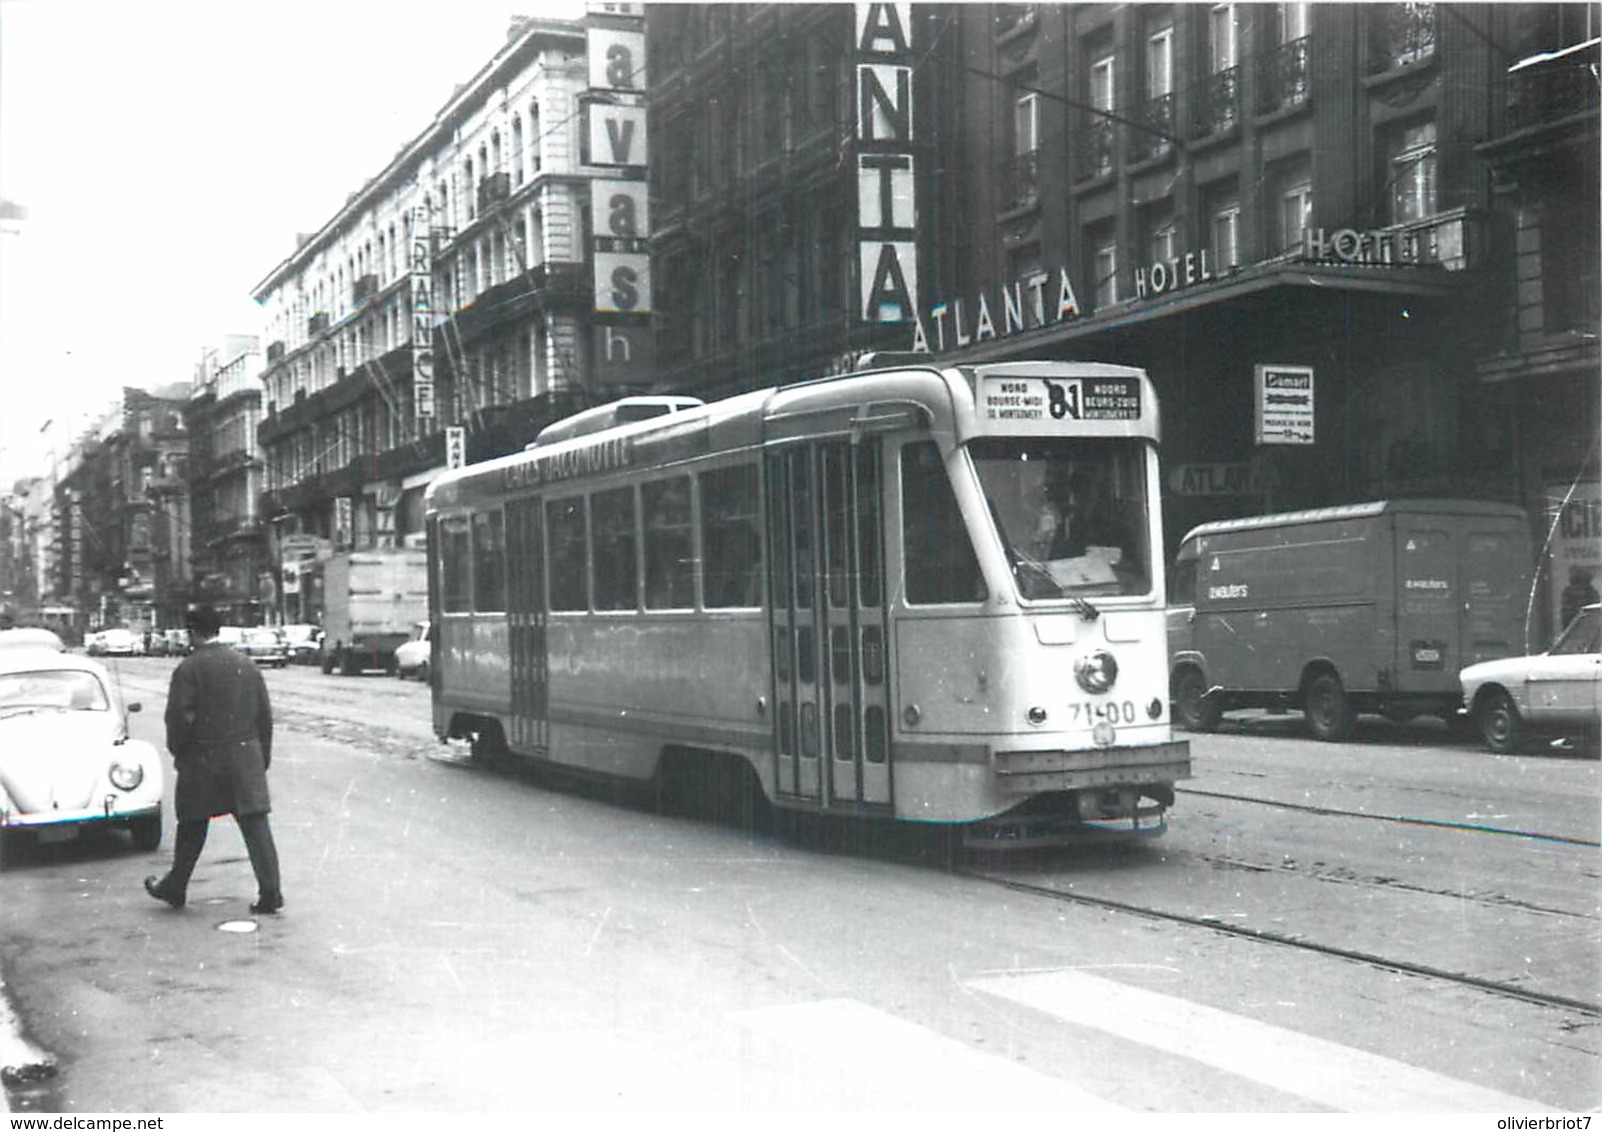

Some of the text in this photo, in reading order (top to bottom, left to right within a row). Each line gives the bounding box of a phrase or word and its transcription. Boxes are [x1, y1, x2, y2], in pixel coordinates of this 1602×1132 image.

[911, 249, 1211, 353] ATLANTA HOTEL
[1049, 383, 1080, 419] 81
[1068, 700, 1136, 726] 7100
